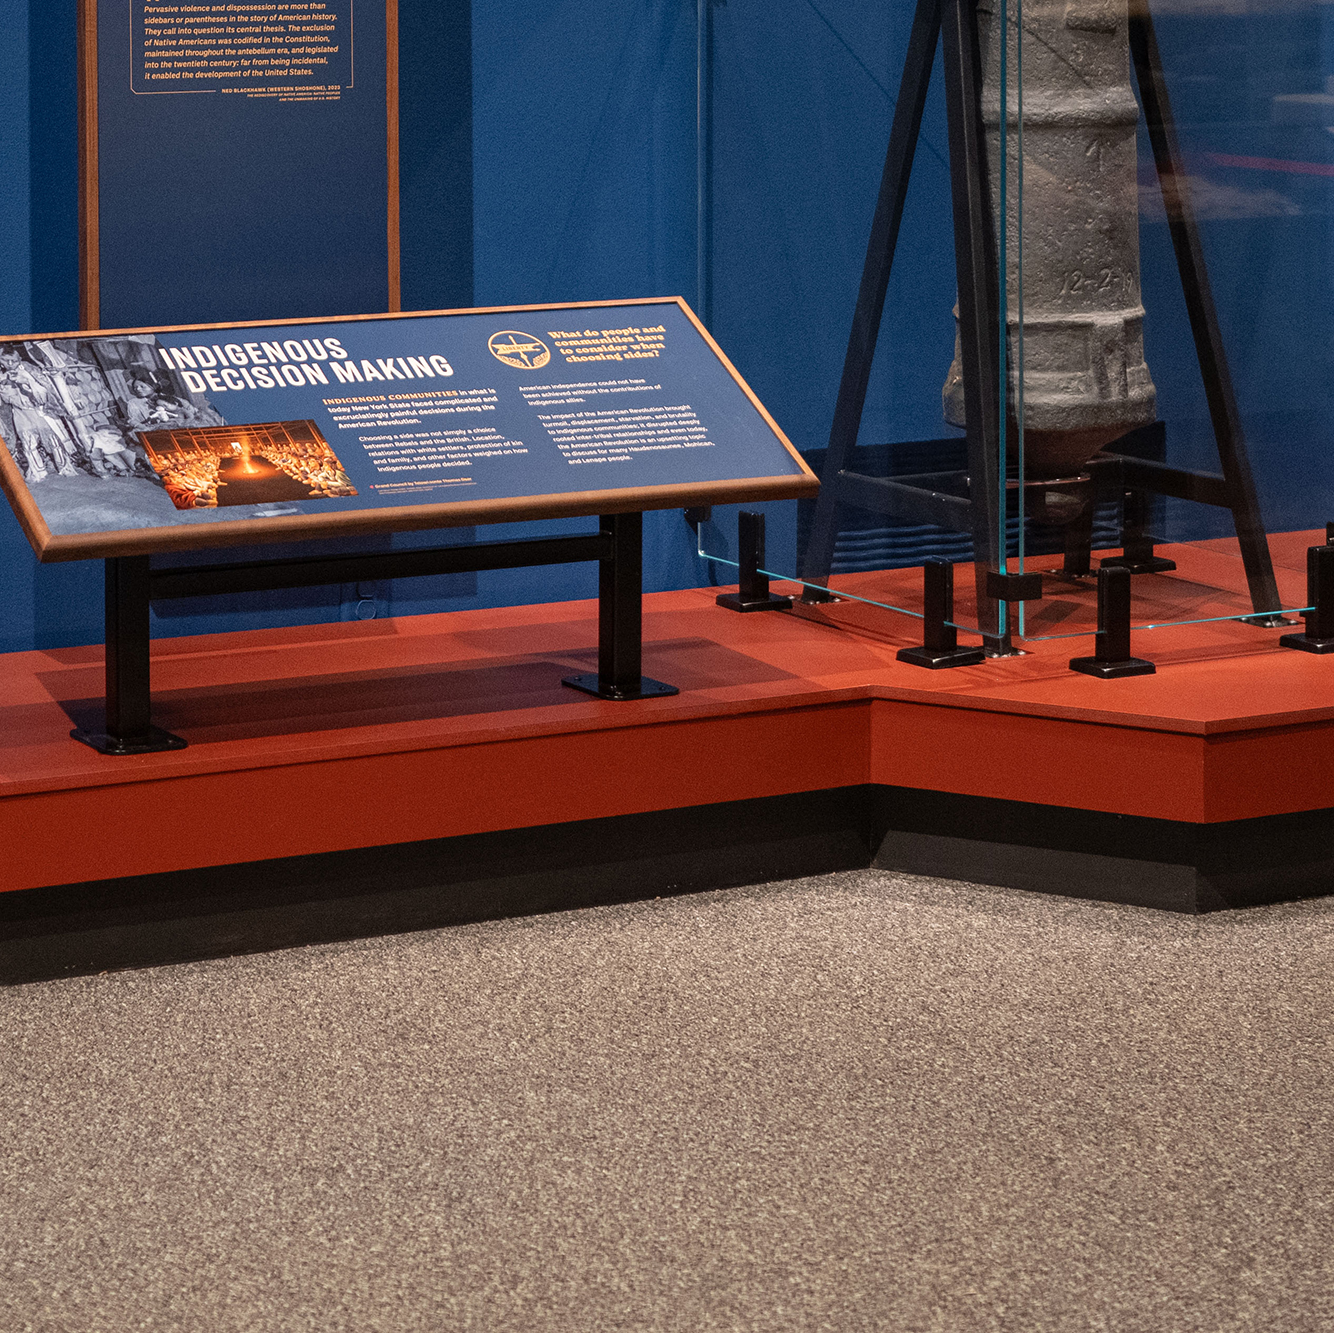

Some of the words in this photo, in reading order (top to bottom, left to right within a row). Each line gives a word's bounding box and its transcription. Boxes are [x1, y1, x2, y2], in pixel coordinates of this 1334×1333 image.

[548, 330, 582, 340] What
[583, 329, 599, 338] do
[601, 326, 641, 338] people
[642, 324, 666, 334] and
[554, 336, 634, 347] communities
[634, 333, 665, 342] have
[158, 336, 349, 370] INDIGENOUS
[501, 344, 529, 353] LIBERTY
[559, 347, 574, 355] to
[575, 344, 630, 354] consider
[630, 341, 666, 350] when
[565, 352, 624, 363] choosing
[624, 349, 660, 359] sides?
[180, 362, 330, 394] DECISION
[329, 354, 455, 384] MAKING
[322, 394, 386, 406] INDIGENOUS
[388, 389, 459, 401] COMMUNITIES
[468, 387, 488, 396] what
[488, 387, 497, 395] is
